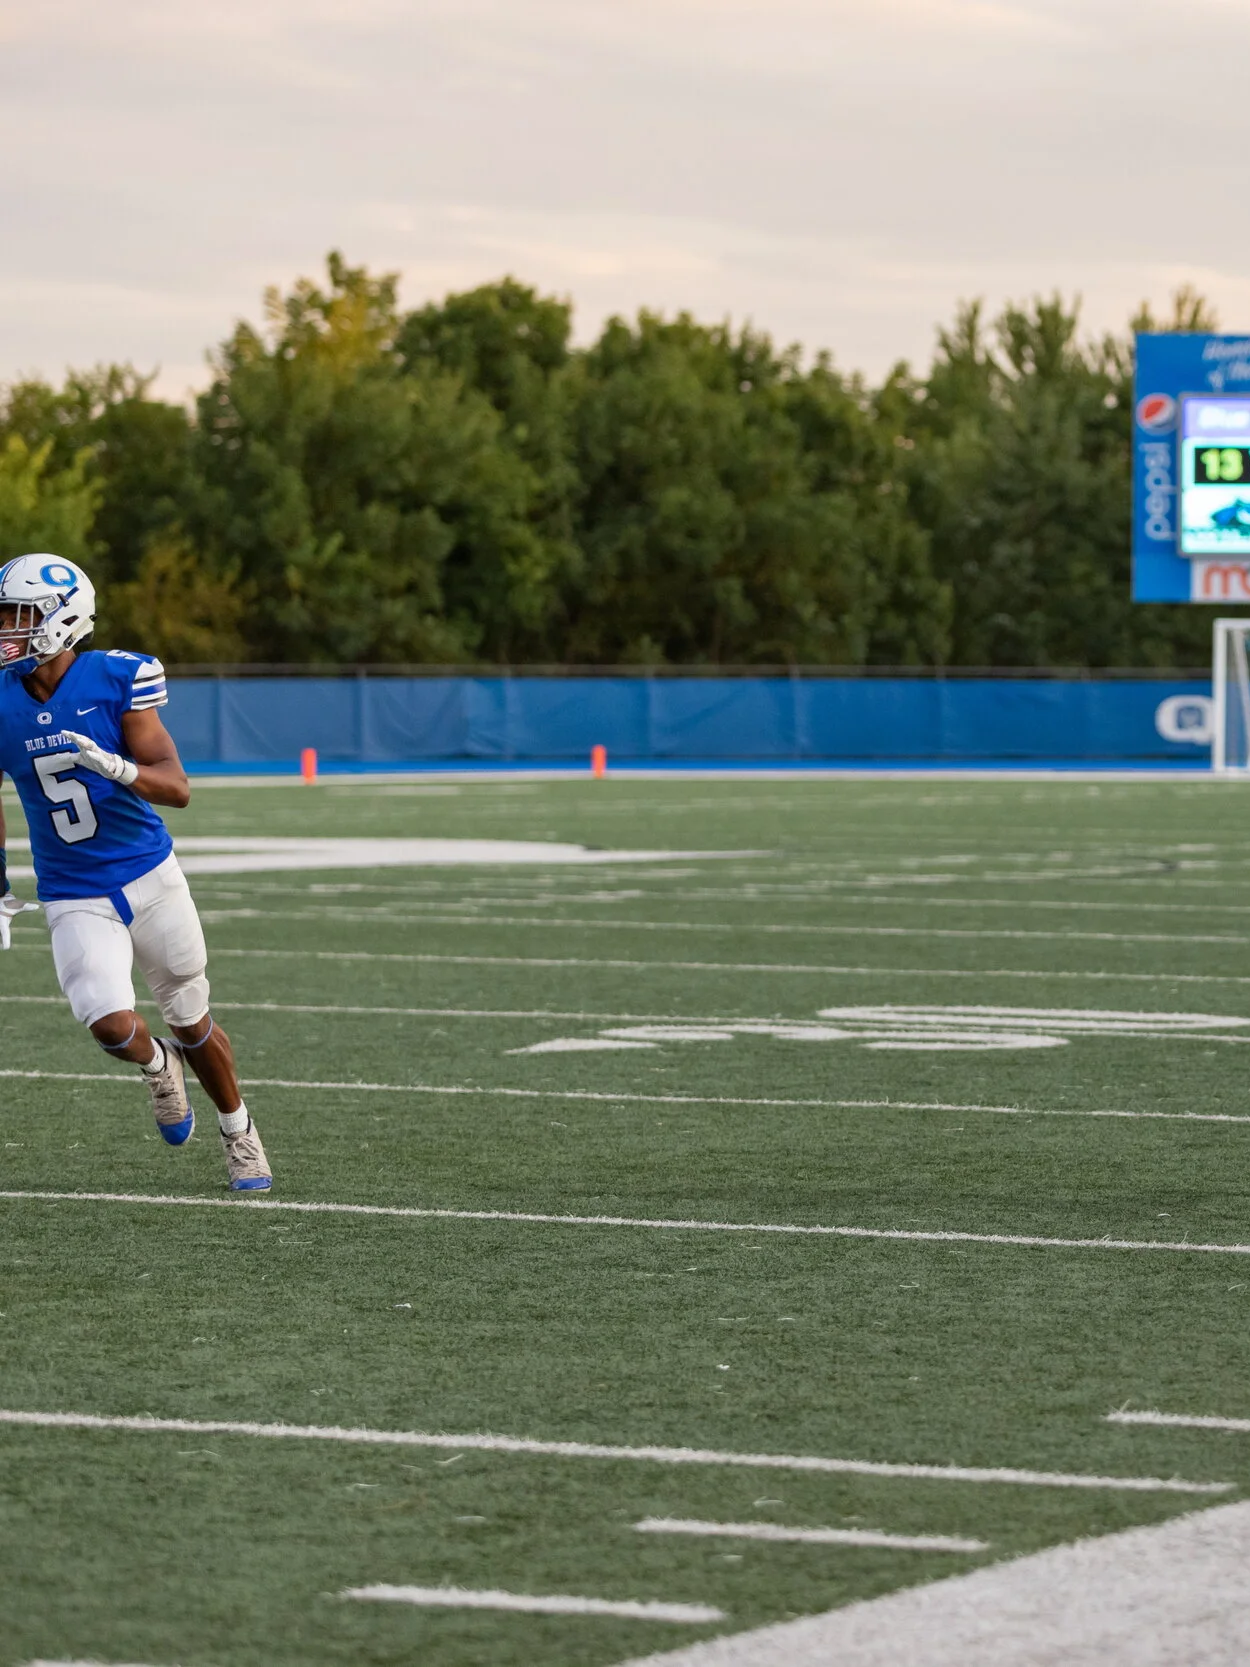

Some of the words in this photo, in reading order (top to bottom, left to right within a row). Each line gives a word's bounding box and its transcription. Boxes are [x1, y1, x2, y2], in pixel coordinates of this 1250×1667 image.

[1201, 448, 1244, 481] 13
[1138, 443, 1177, 540] pepsi
[40, 564, 78, 588] Q
[25, 736, 46, 752] BLUE
[46, 733, 72, 748] DEVIL
[33, 752, 98, 844] 5
